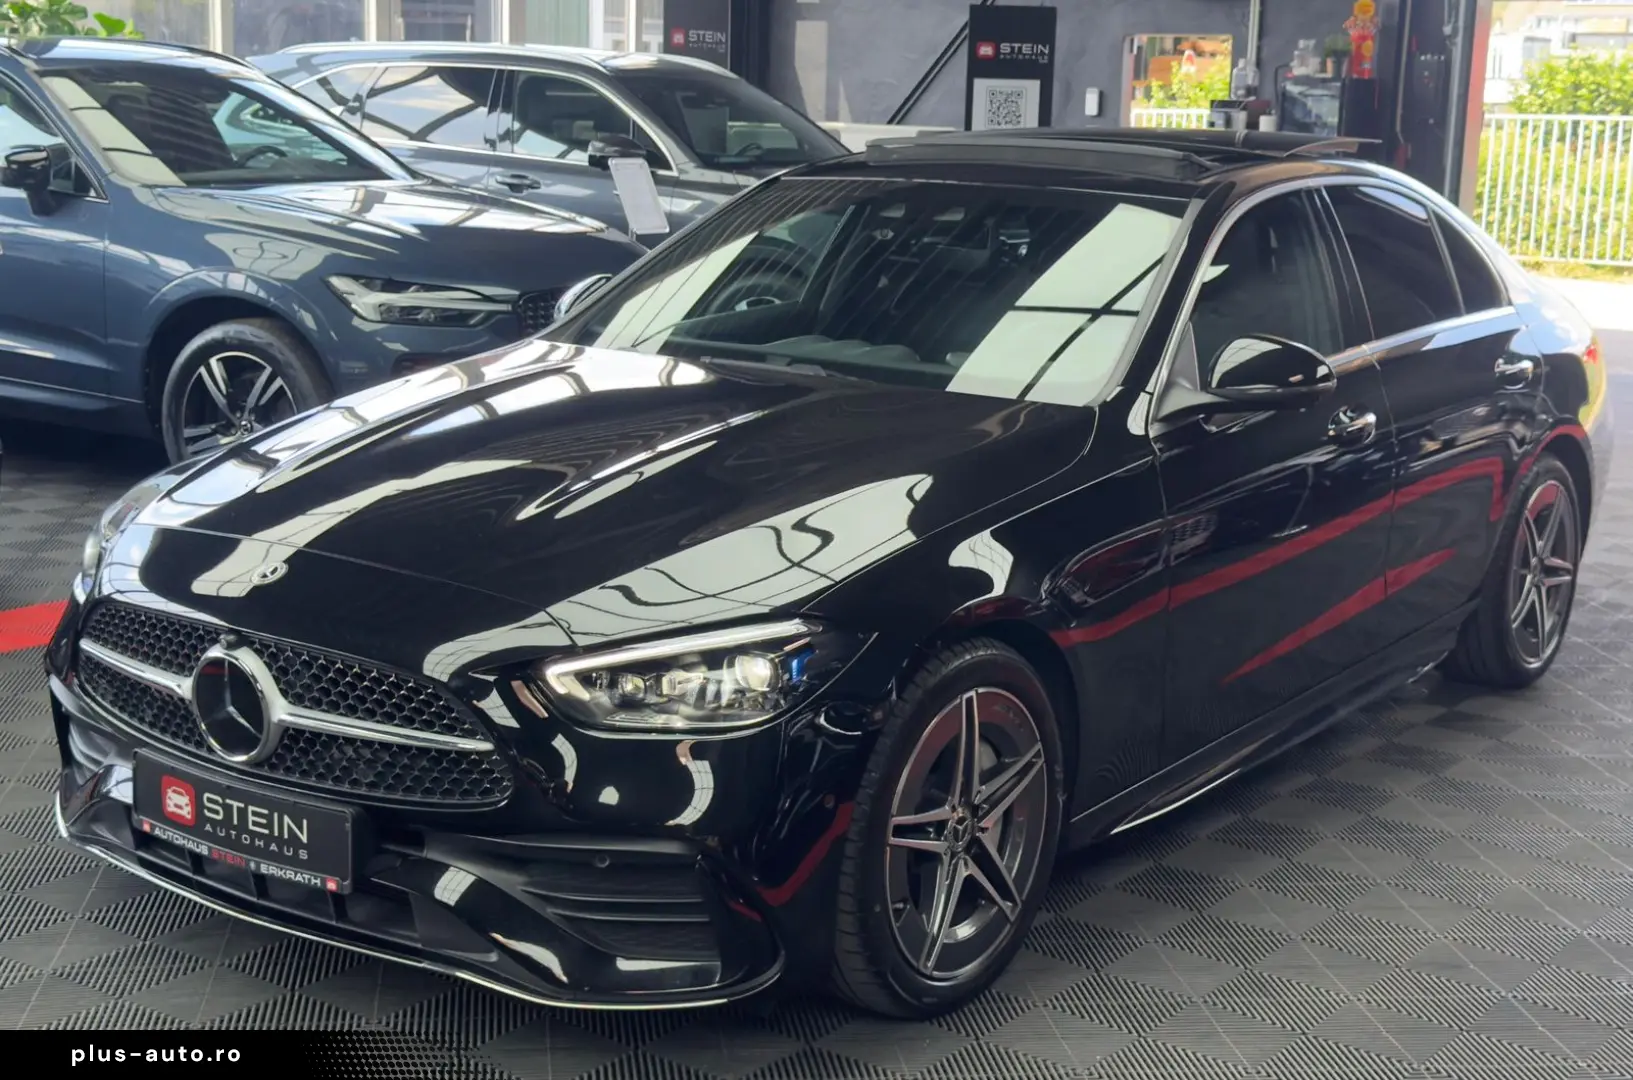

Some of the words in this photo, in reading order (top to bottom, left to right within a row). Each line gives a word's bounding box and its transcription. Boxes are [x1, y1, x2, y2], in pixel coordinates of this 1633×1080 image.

[688, 30, 726, 43] STEIN
[999, 43, 1049, 54] STEIN
[203, 792, 308, 843] STEIN
[154, 826, 209, 855] AUTOHAUS
[211, 849, 246, 867] STEIN
[260, 864, 321, 886] ERKRATH
[204, 823, 308, 860] AUTOHAUS
